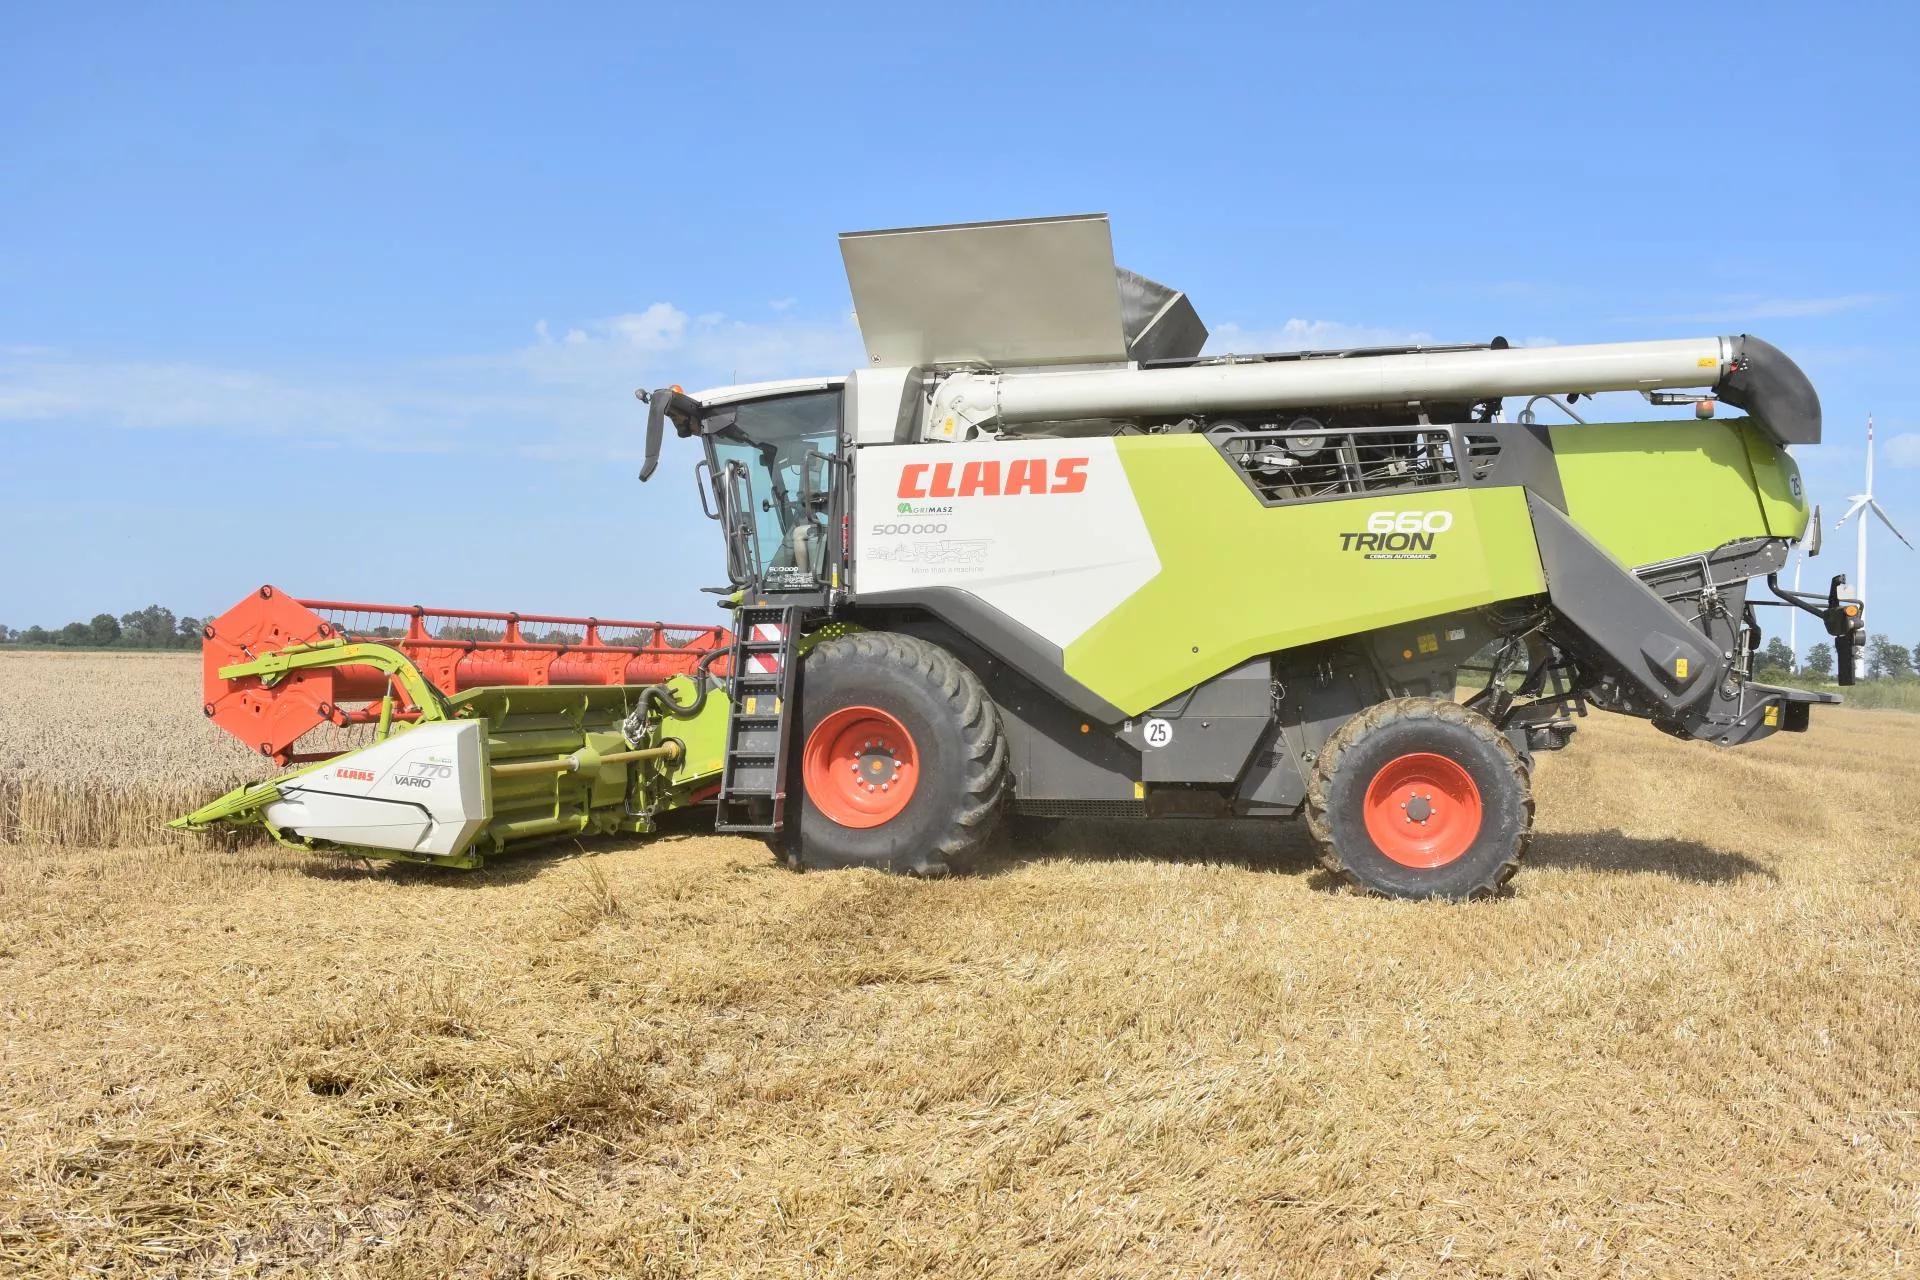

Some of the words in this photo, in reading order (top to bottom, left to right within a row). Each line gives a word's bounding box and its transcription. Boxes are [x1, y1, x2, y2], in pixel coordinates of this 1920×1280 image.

[897, 458, 1089, 498] CLAAS
[1367, 511, 1452, 533] 660
[1340, 533, 1434, 551] TRION
[1150, 724, 1166, 741] 25
[336, 768, 375, 781] CLAAS
[418, 764, 451, 778] 770
[395, 776, 431, 788] VARIO
